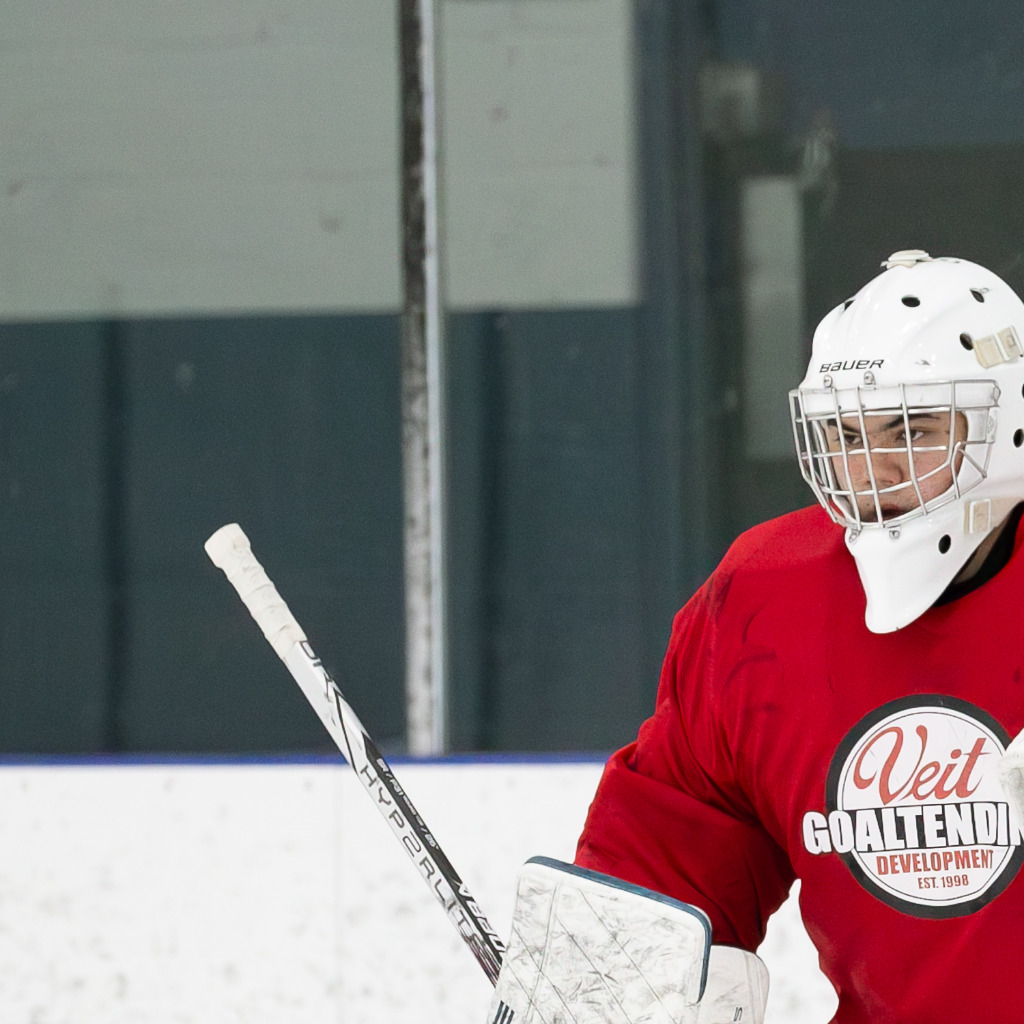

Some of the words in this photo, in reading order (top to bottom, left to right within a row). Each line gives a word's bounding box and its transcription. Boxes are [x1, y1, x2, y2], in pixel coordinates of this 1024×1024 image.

[819, 358, 884, 374] BAUER
[853, 724, 992, 805] Veit
[876, 848, 994, 876] DEVELOPMENT
[917, 876, 939, 890] EST.
[942, 873, 970, 888] 1998
